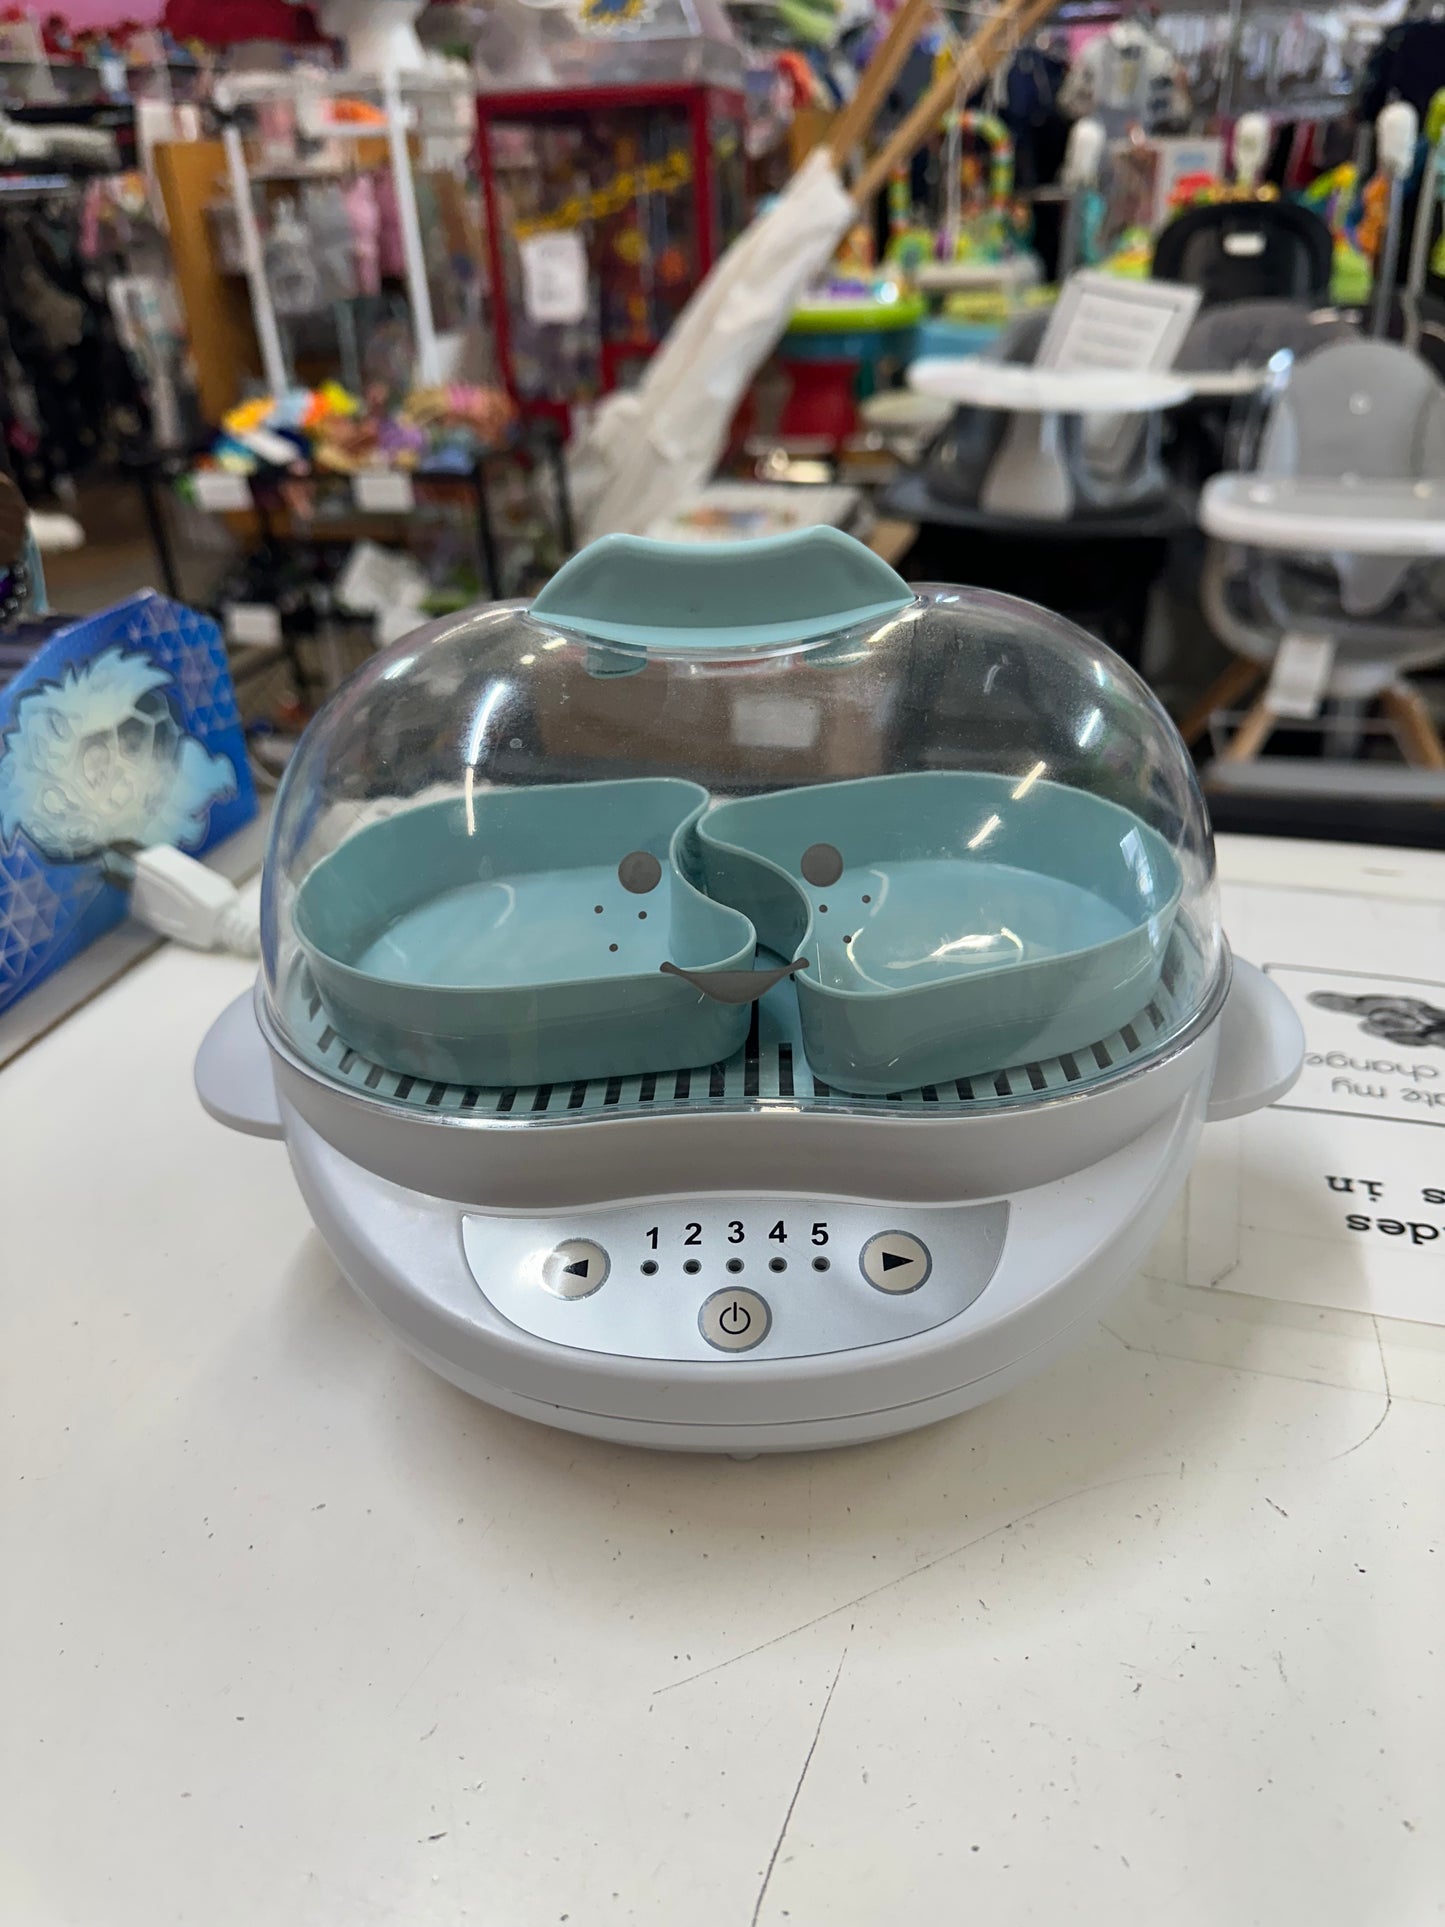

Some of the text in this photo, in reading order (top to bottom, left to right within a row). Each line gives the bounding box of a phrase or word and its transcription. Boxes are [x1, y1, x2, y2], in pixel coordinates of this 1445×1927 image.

[1303, 1052, 1438, 1082] change
[1331, 1076, 1387, 1099] my
[1324, 1175, 1383, 1202] in
[646, 1220, 829, 1250] 1 2 3 4 5
[1345, 1213, 1445, 1245] des
